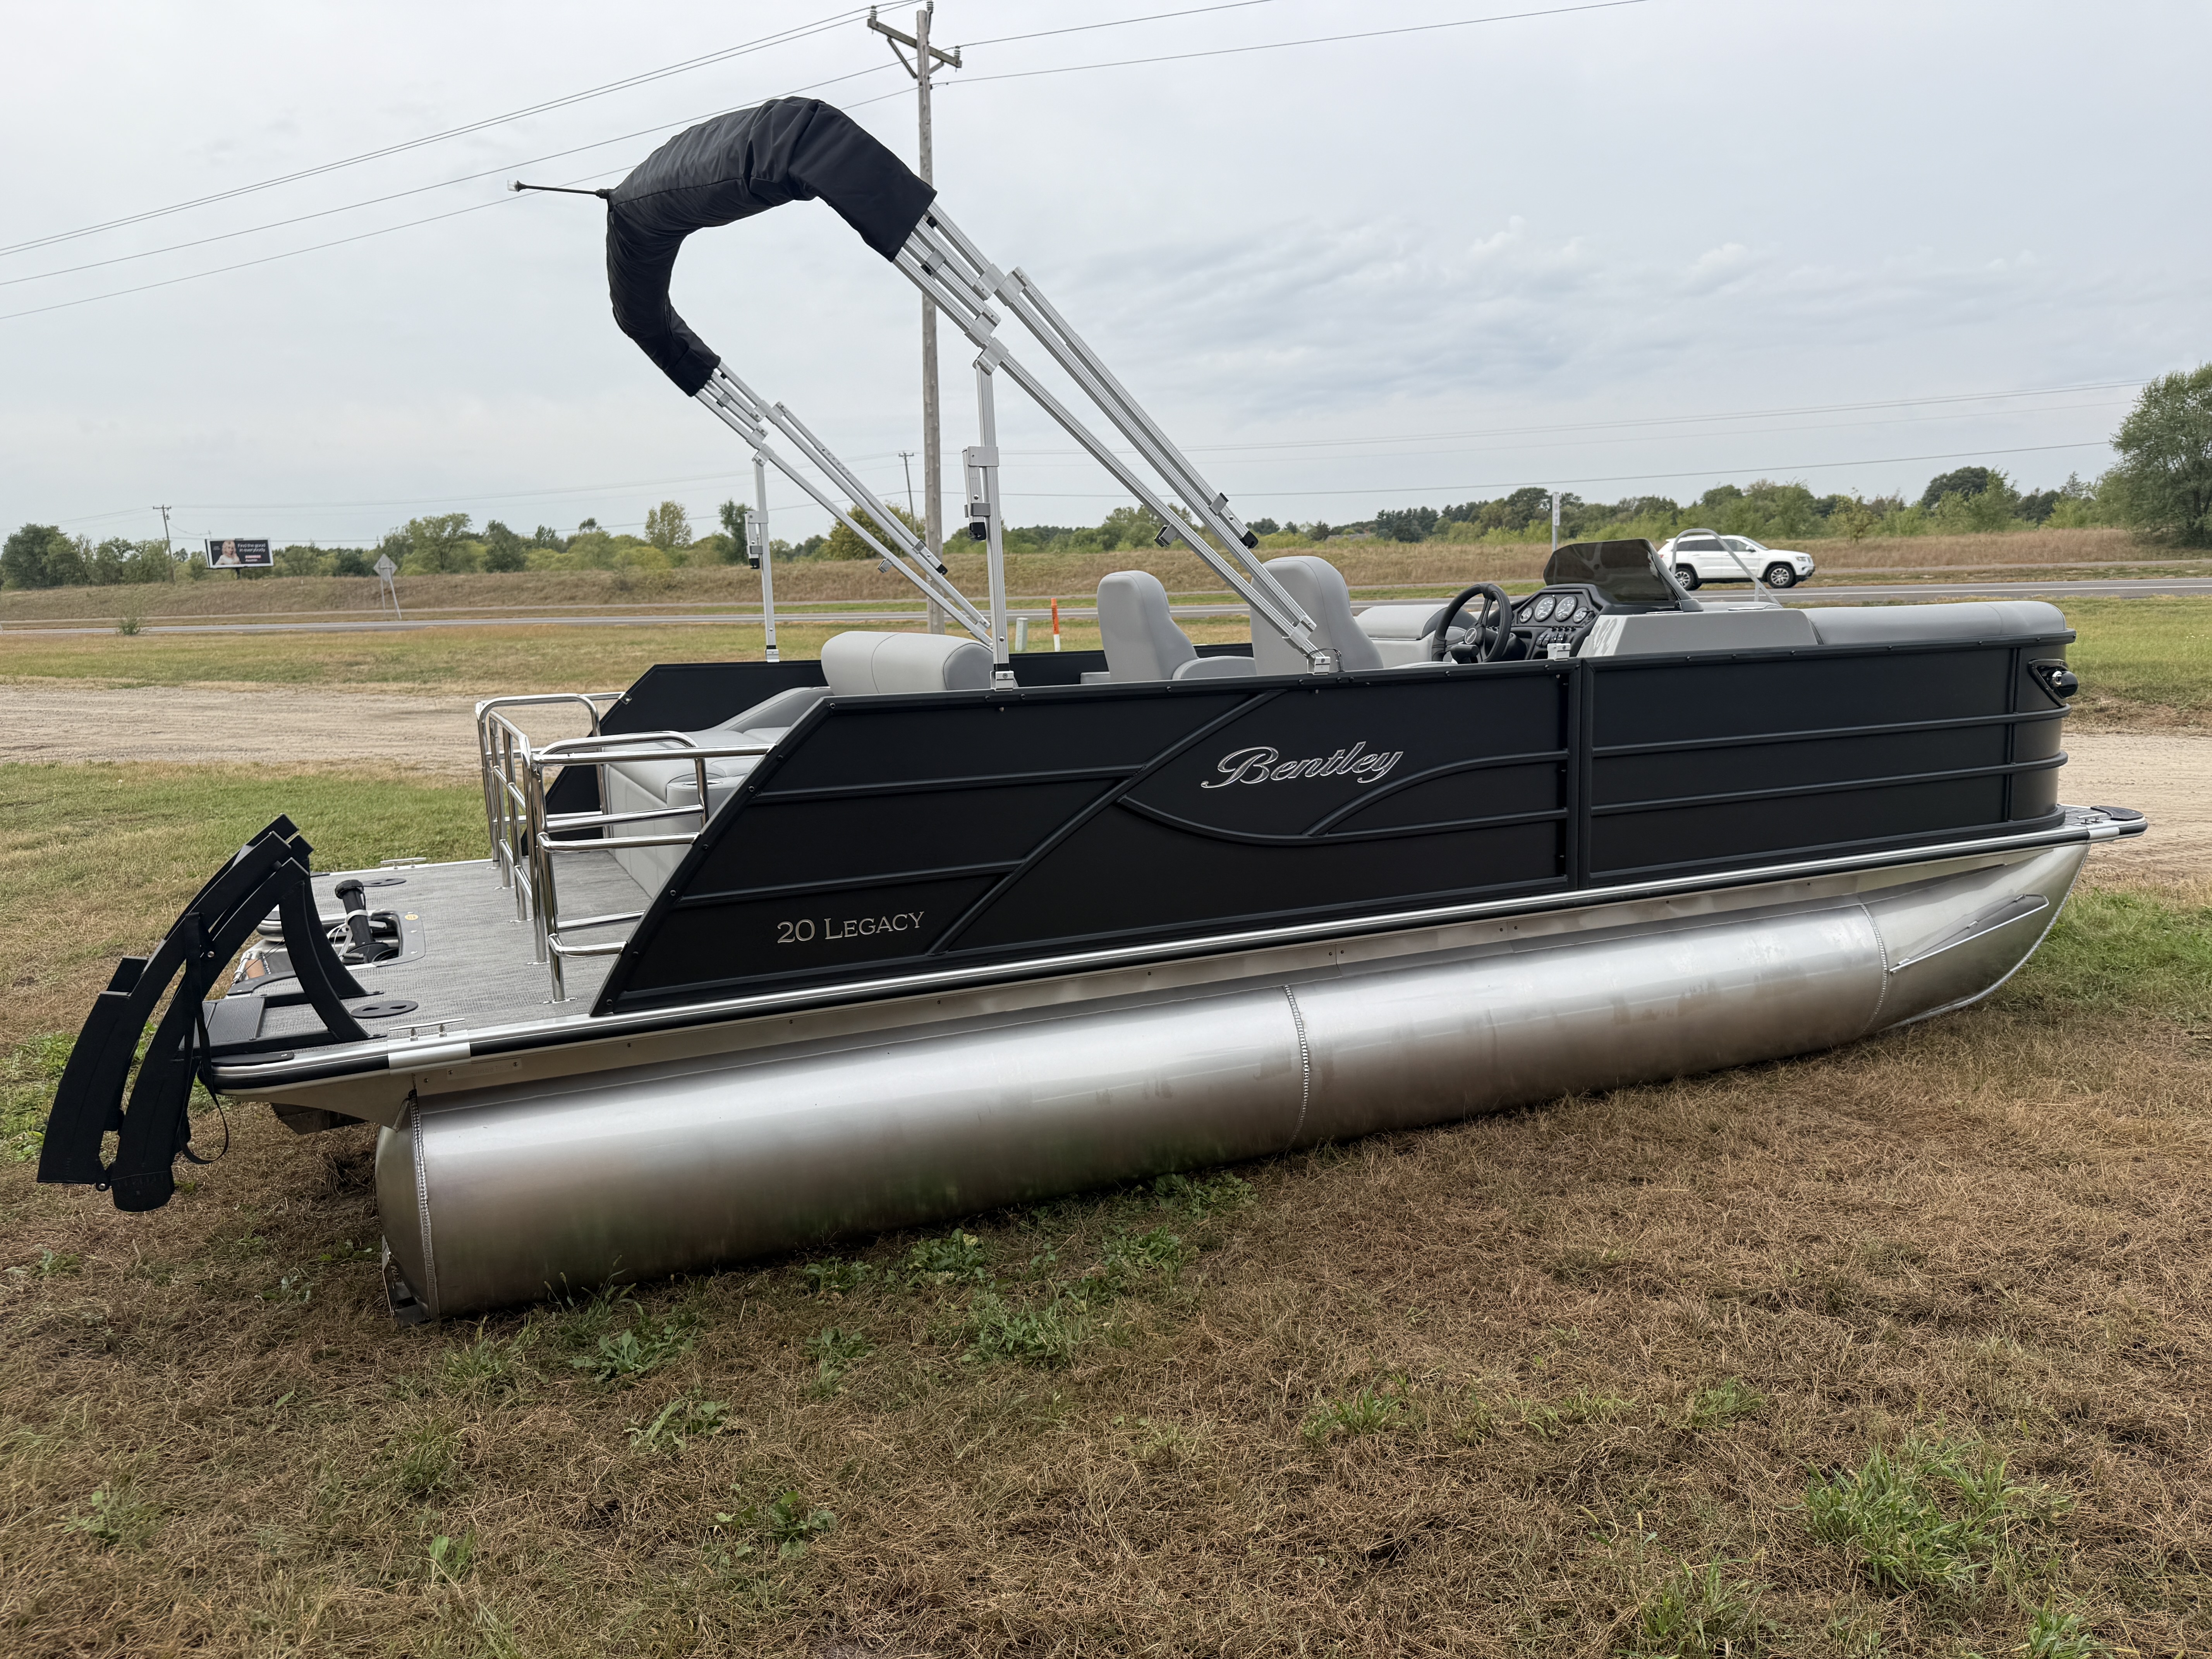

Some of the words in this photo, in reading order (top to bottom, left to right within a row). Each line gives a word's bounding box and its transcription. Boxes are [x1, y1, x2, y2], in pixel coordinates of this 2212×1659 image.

[1200, 741, 1403, 788] Bentley
[777, 919, 815, 943] 20
[824, 911, 924, 939] LEGACY
